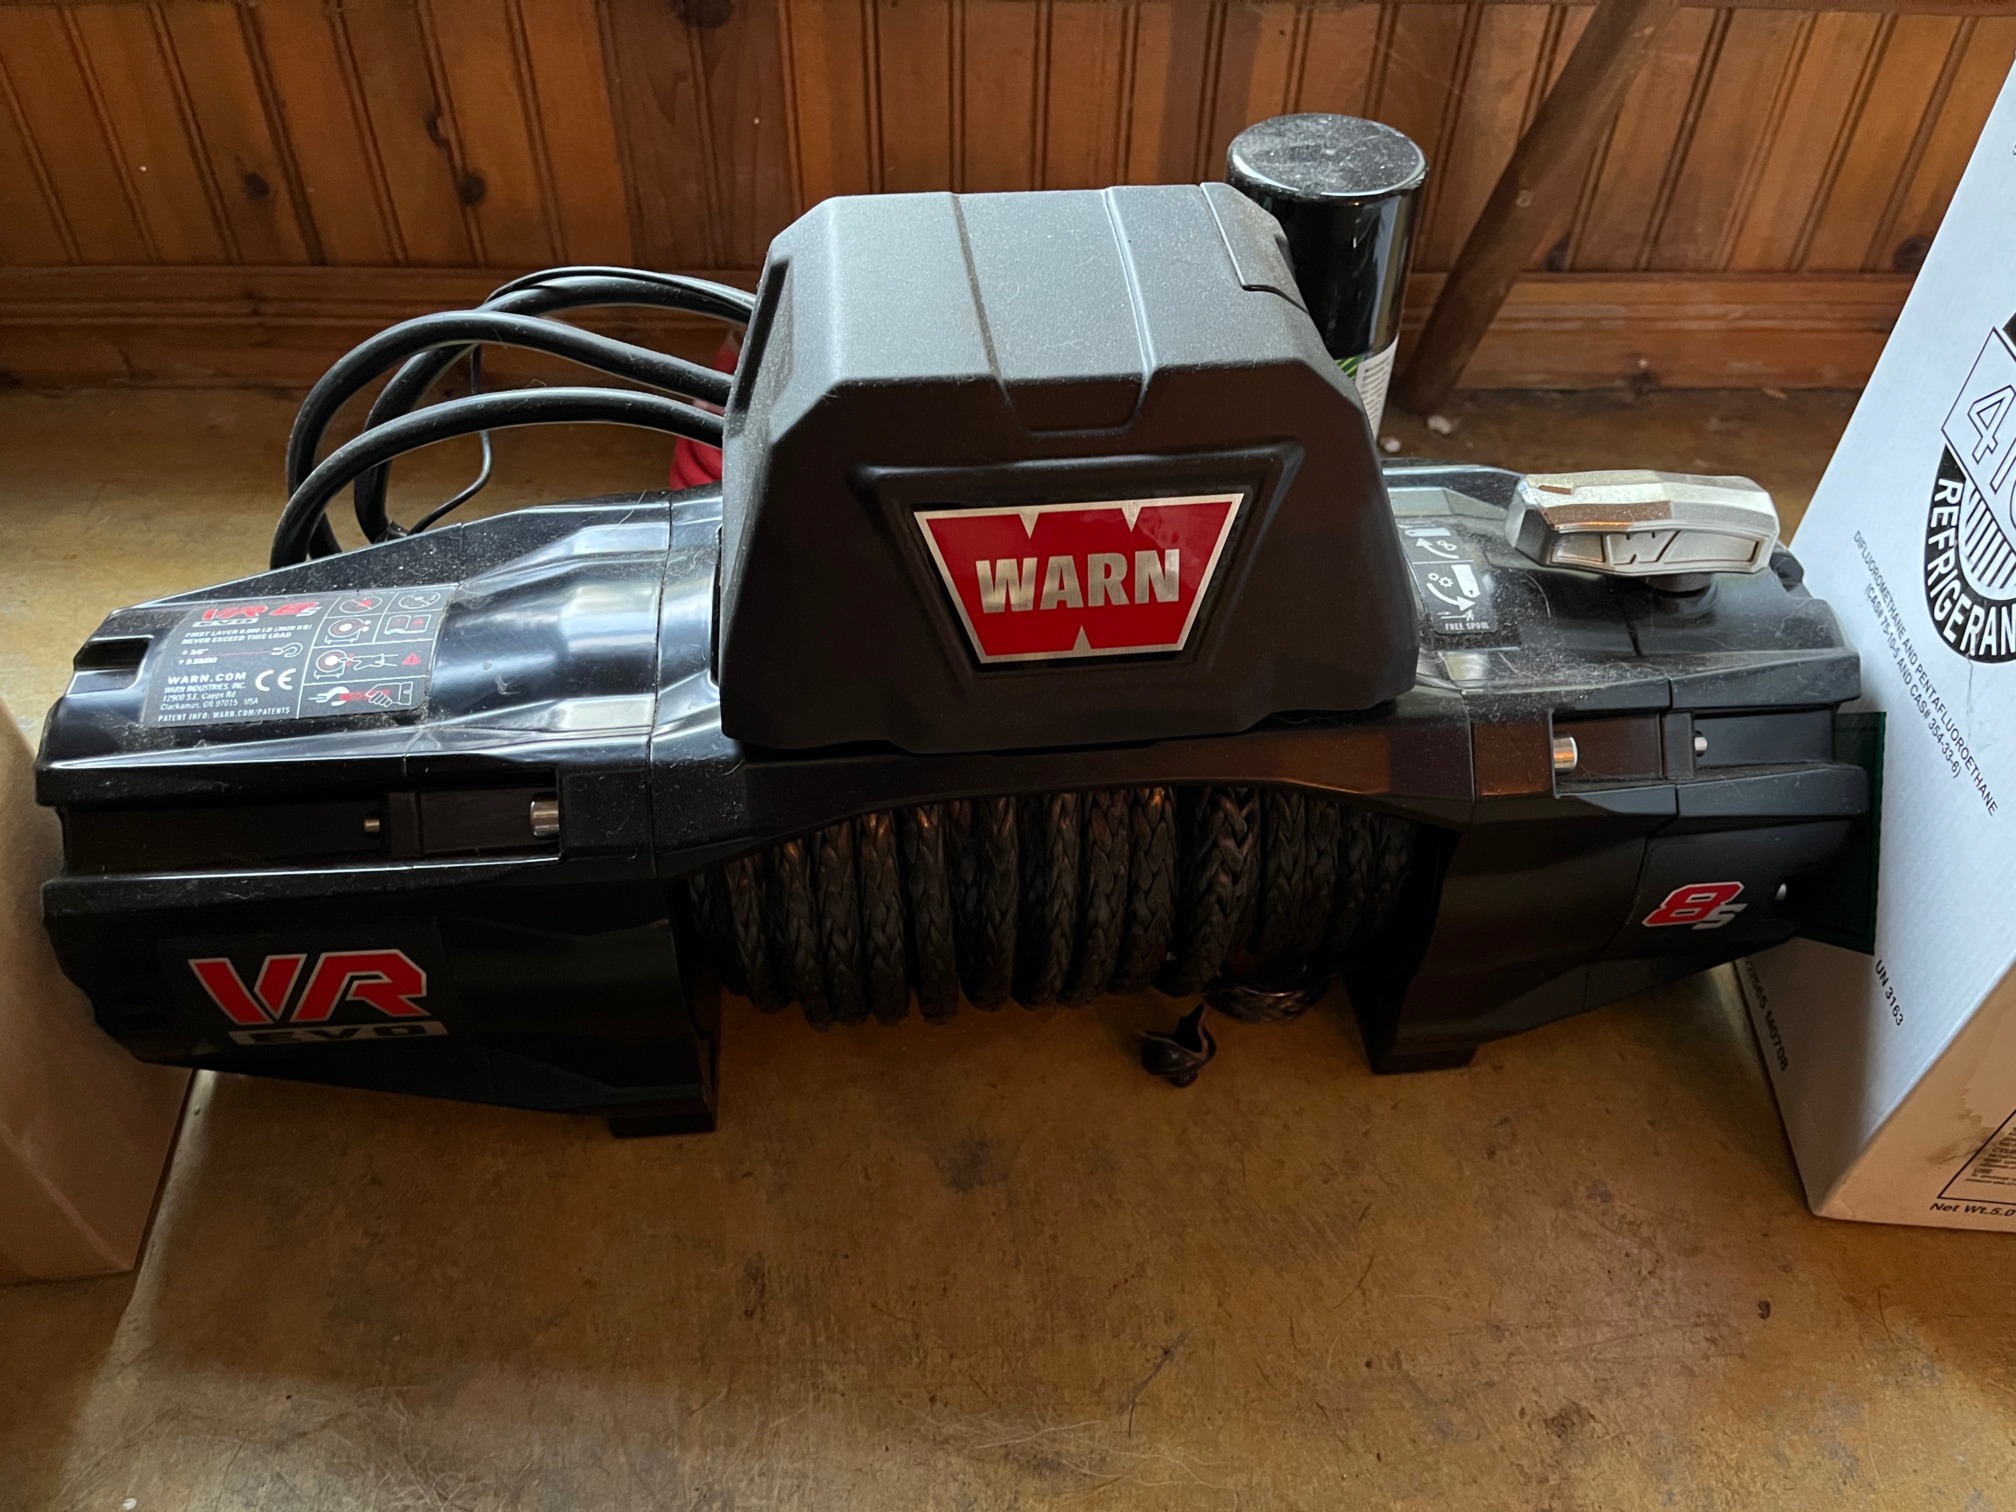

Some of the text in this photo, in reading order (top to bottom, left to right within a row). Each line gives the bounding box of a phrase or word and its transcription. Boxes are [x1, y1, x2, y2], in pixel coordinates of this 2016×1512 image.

[975, 548, 1180, 614] WARN
[1445, 621, 1490, 631] FREE SPOOL
[182, 632, 292, 645] NEVER EXCEED THIS LOAD
[185, 630, 208, 638] FIRST
[211, 629, 238, 637] LAYER
[167, 672, 247, 685] WARN.COM
[1853, 530, 1998, 817] DIFLUOROMETHANE AND PENTAFLUOROETHANE
[231, 681, 246, 690] INC.
[163, 693, 185, 702] 12900
[201, 691, 224, 701] Capps
[225, 690, 236, 698] Rd
[203, 700, 214, 708] OR
[215, 699, 238, 708] 97015
[243, 698, 259, 706] USA
[158, 713, 186, 722] PATENT
[213, 706, 291, 719] WARN.COM/PATENTS
[1897, 657, 1912, 685] AND
[1910, 684, 1930, 720] CAS#
[1928, 718, 1962, 779] 354-33-6)
[188, 949, 431, 1025] VR
[1875, 959, 1904, 1026] UN 3163
[243, 1022, 433, 1045] EVO
[1929, 1202, 1959, 1212] Net
